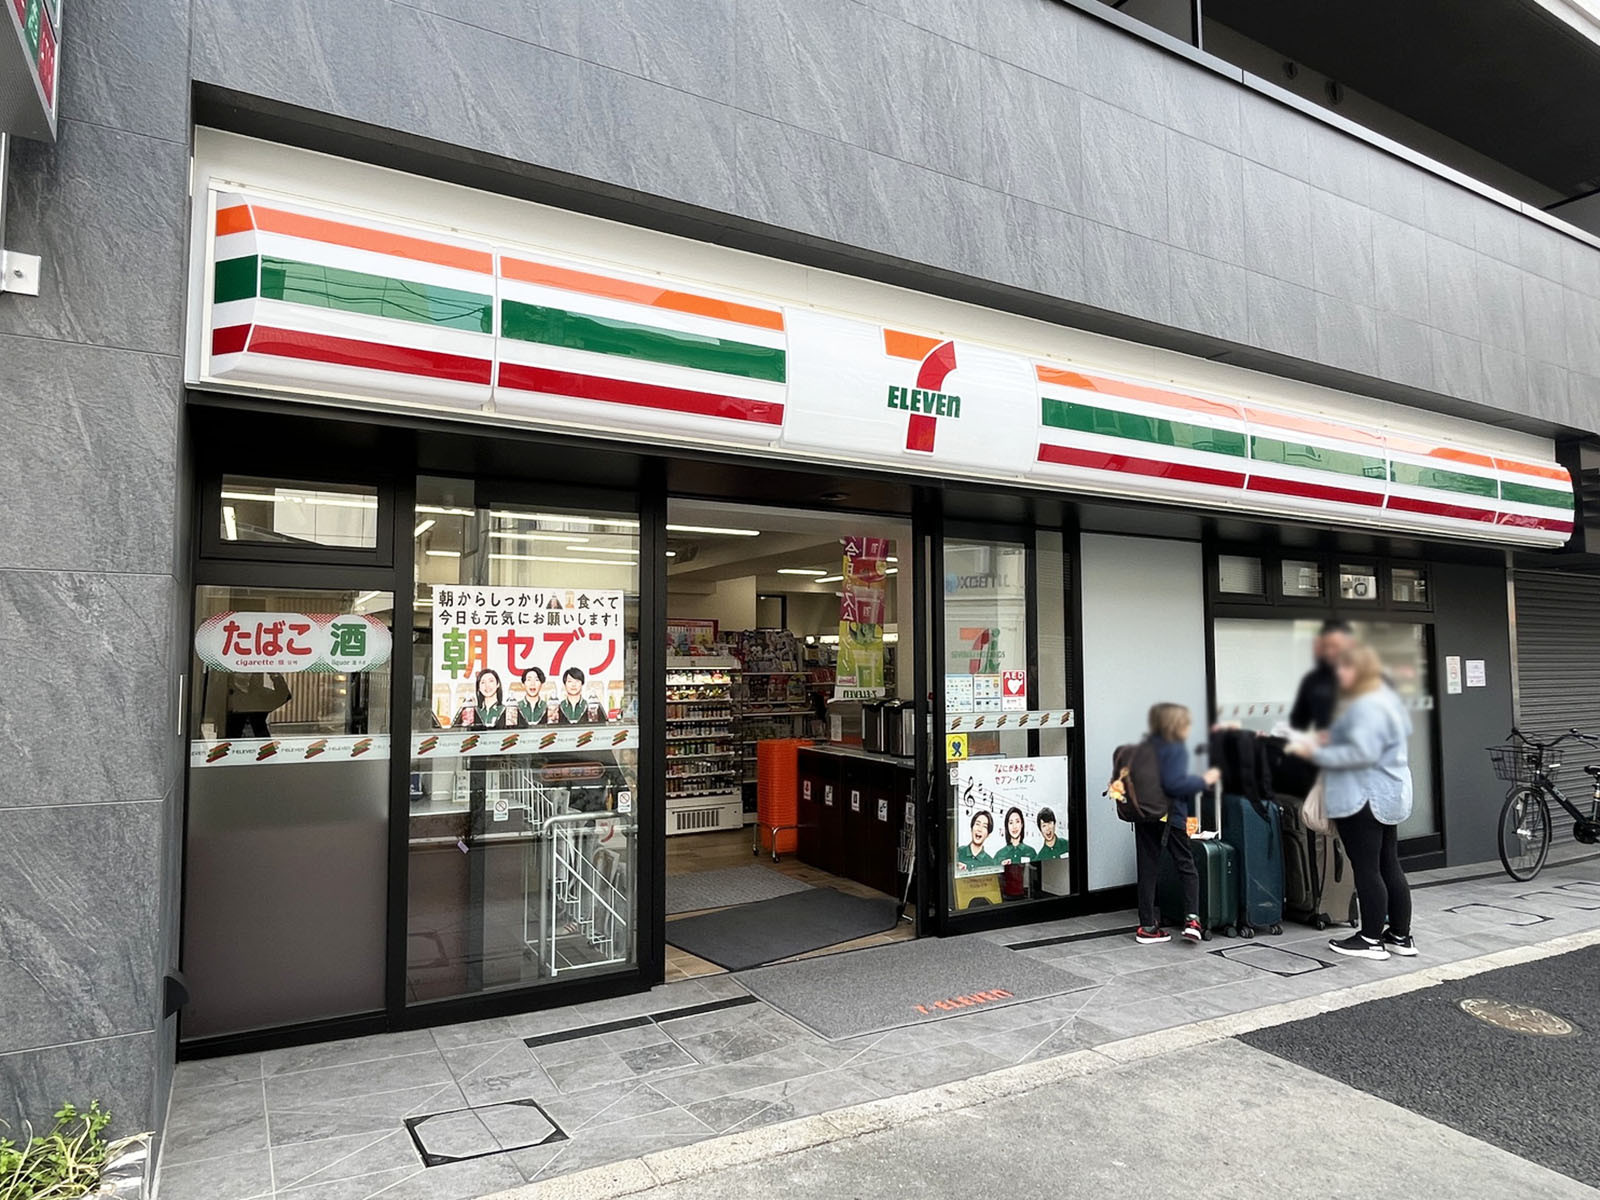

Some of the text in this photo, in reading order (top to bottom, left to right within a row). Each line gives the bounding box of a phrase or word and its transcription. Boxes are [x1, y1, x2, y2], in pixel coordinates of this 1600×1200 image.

[883, 328, 957, 453] 7
[439, 590, 619, 609] 朝からしっかり 食べて
[222, 620, 312, 656] たばこ
[330, 622, 367, 656] 酒
[441, 626, 616, 680] 朝セブン
[1004, 671, 1024, 680] AED
